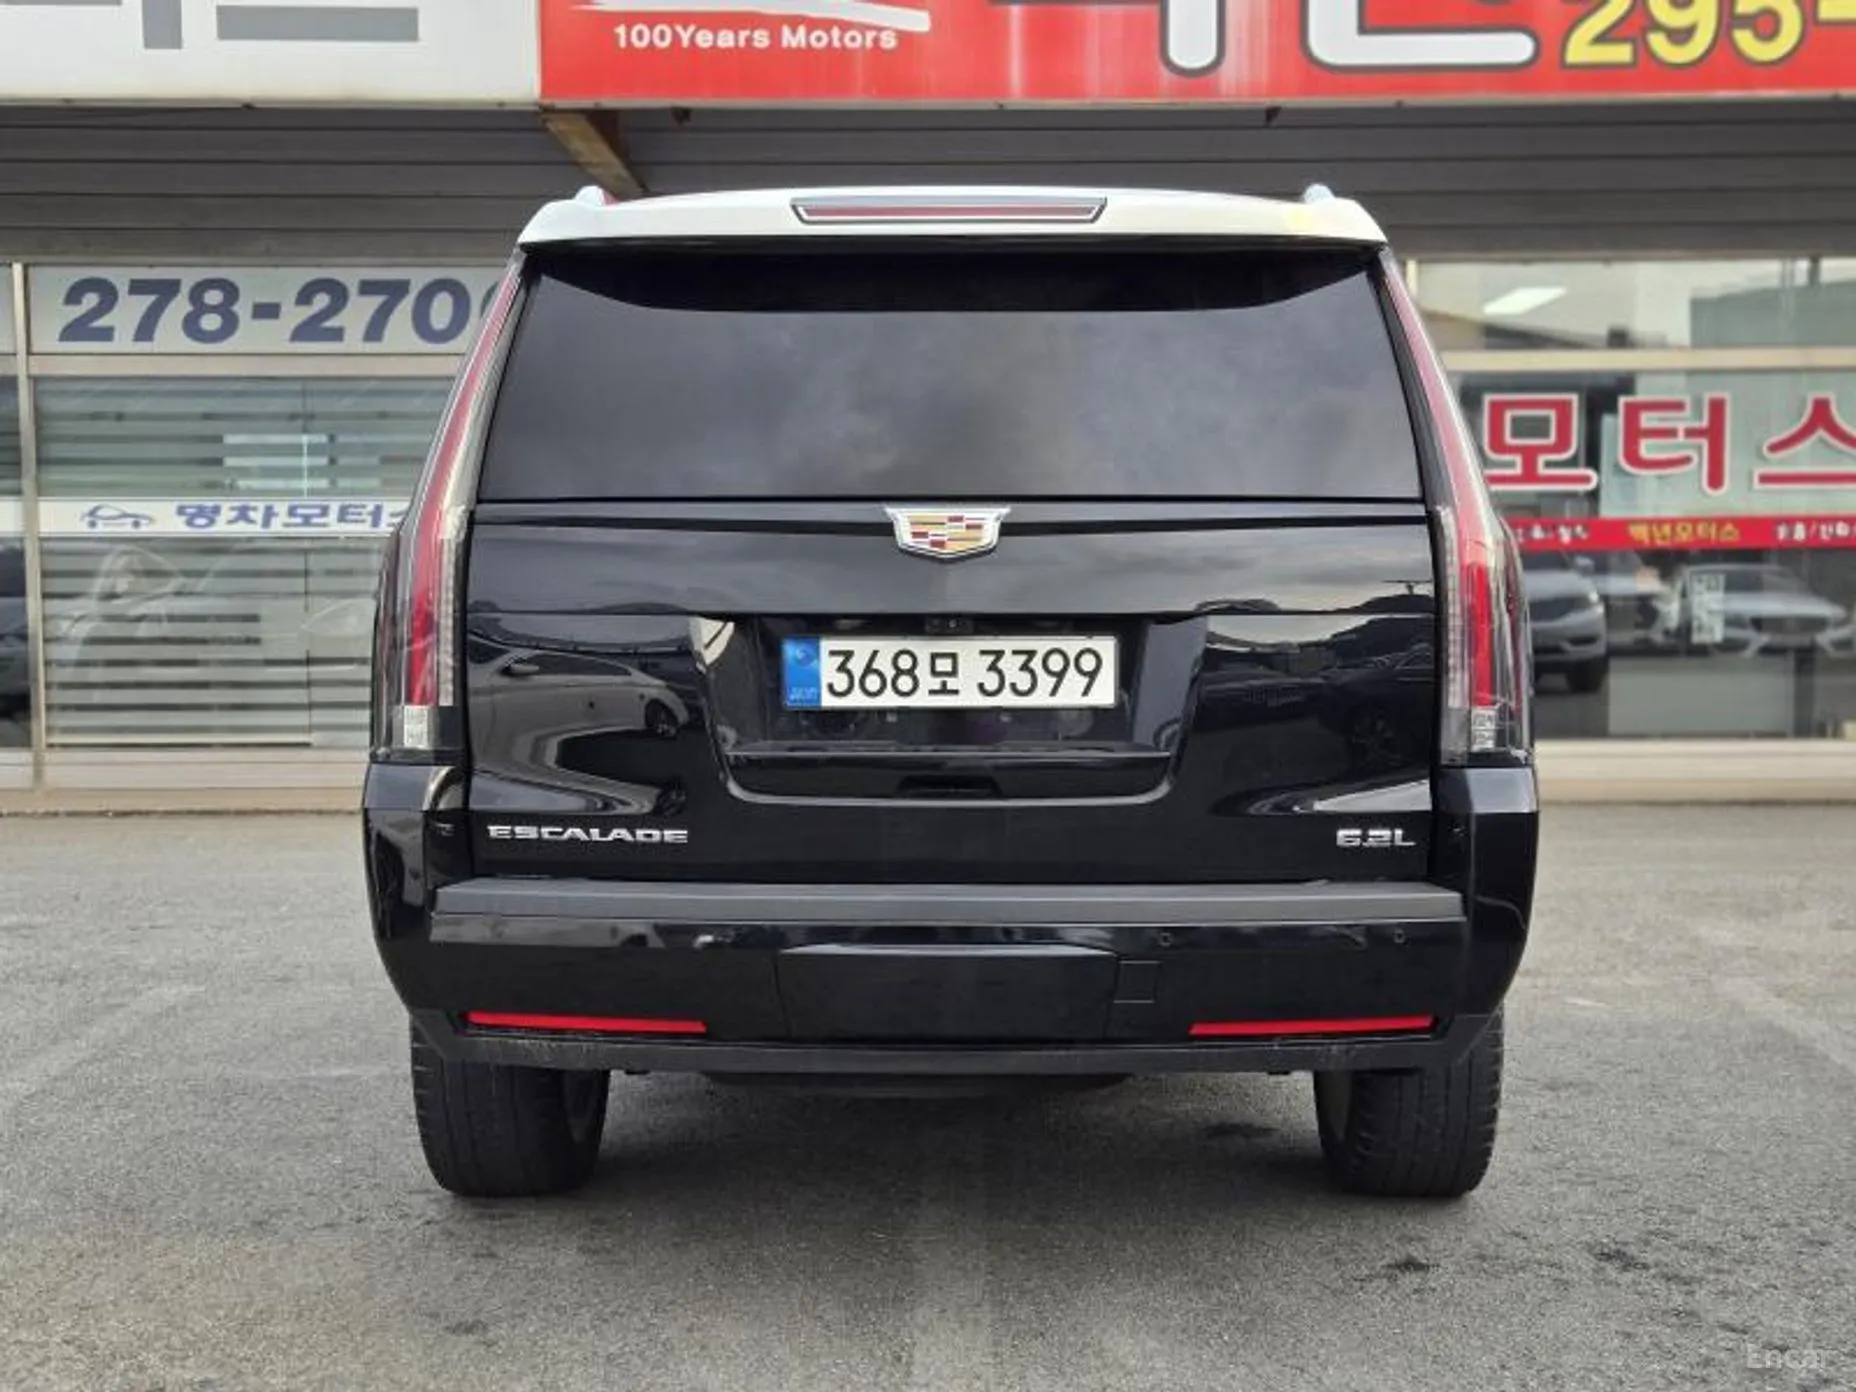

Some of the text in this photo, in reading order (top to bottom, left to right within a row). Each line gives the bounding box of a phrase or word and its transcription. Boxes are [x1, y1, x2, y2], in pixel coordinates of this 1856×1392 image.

[614, 24, 897, 49] 100Years Motors
[58, 277, 500, 345] 278-270
[1484, 394, 1856, 494] 모터스
[827, 647, 1104, 697] 368모 3399
[487, 825, 689, 843] ESCALADE
[1336, 828, 1417, 847] 6.2L
